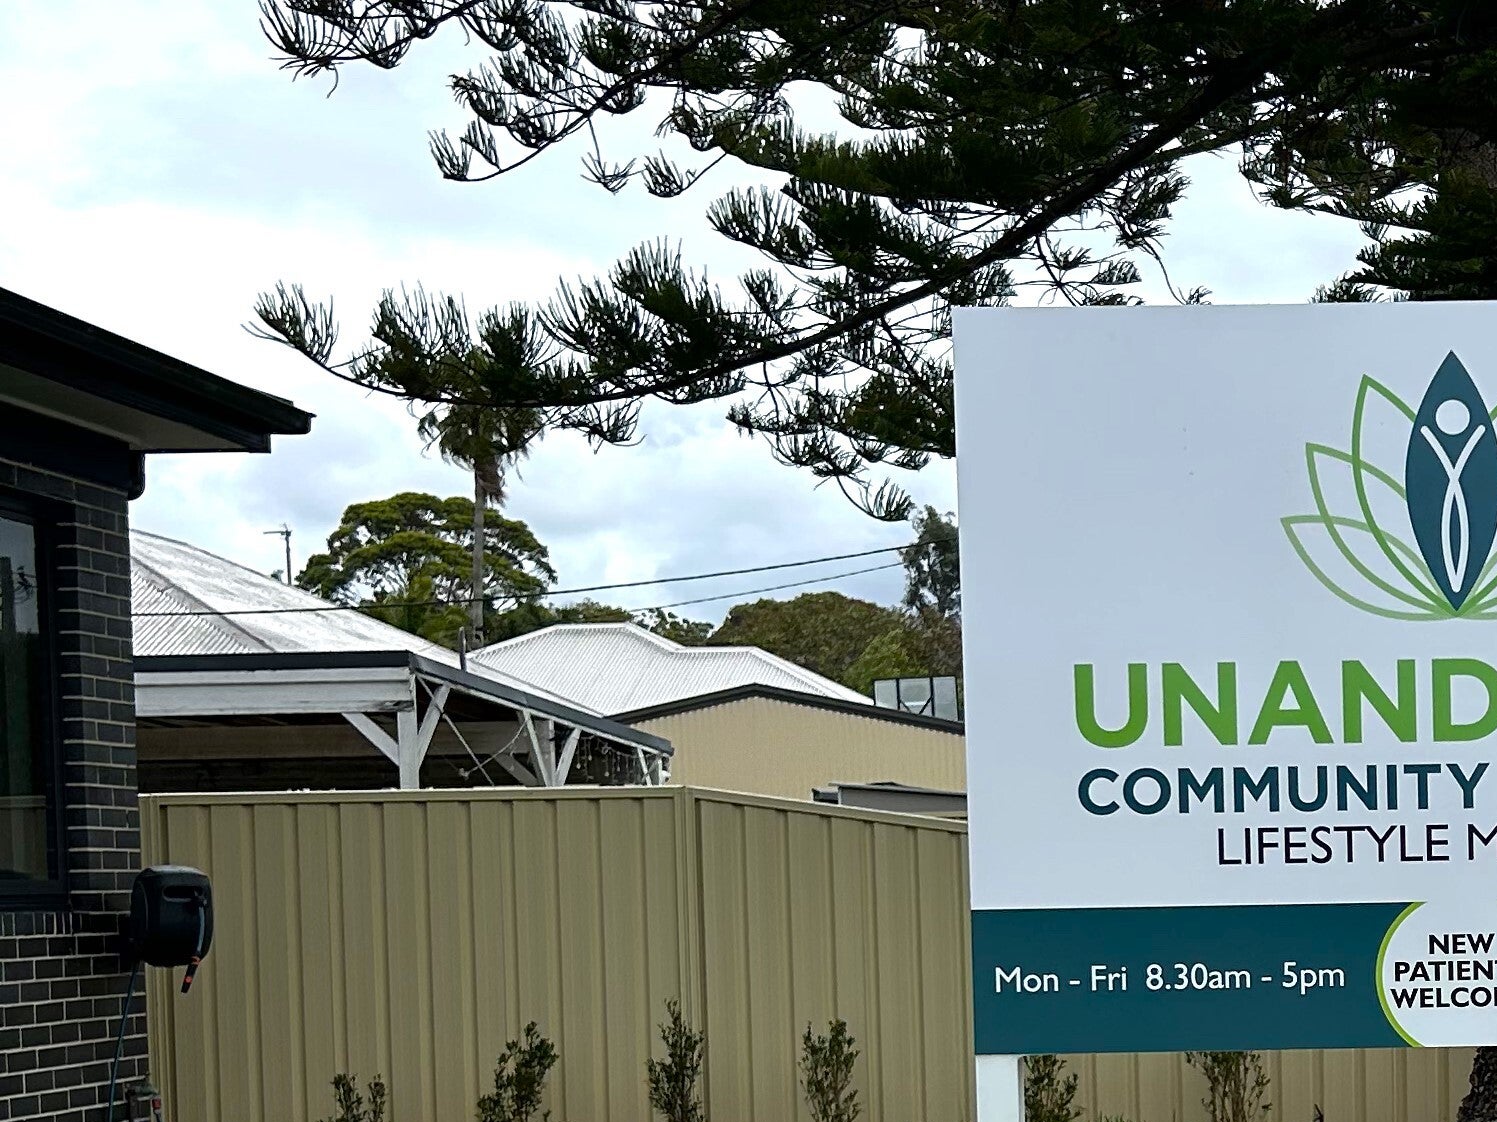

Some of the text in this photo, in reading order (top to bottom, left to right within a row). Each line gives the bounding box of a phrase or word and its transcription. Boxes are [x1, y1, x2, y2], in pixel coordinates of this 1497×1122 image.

[1078, 763, 1490, 816] COMMUNITY
[1218, 824, 1449, 866] LIFESTYLE
[1428, 932, 1496, 956] NEW
[995, 967, 1059, 993] Mon
[1090, 965, 1128, 992] Fri
[1146, 962, 1251, 991] 8.30am
[1282, 962, 1345, 996] 5pm
